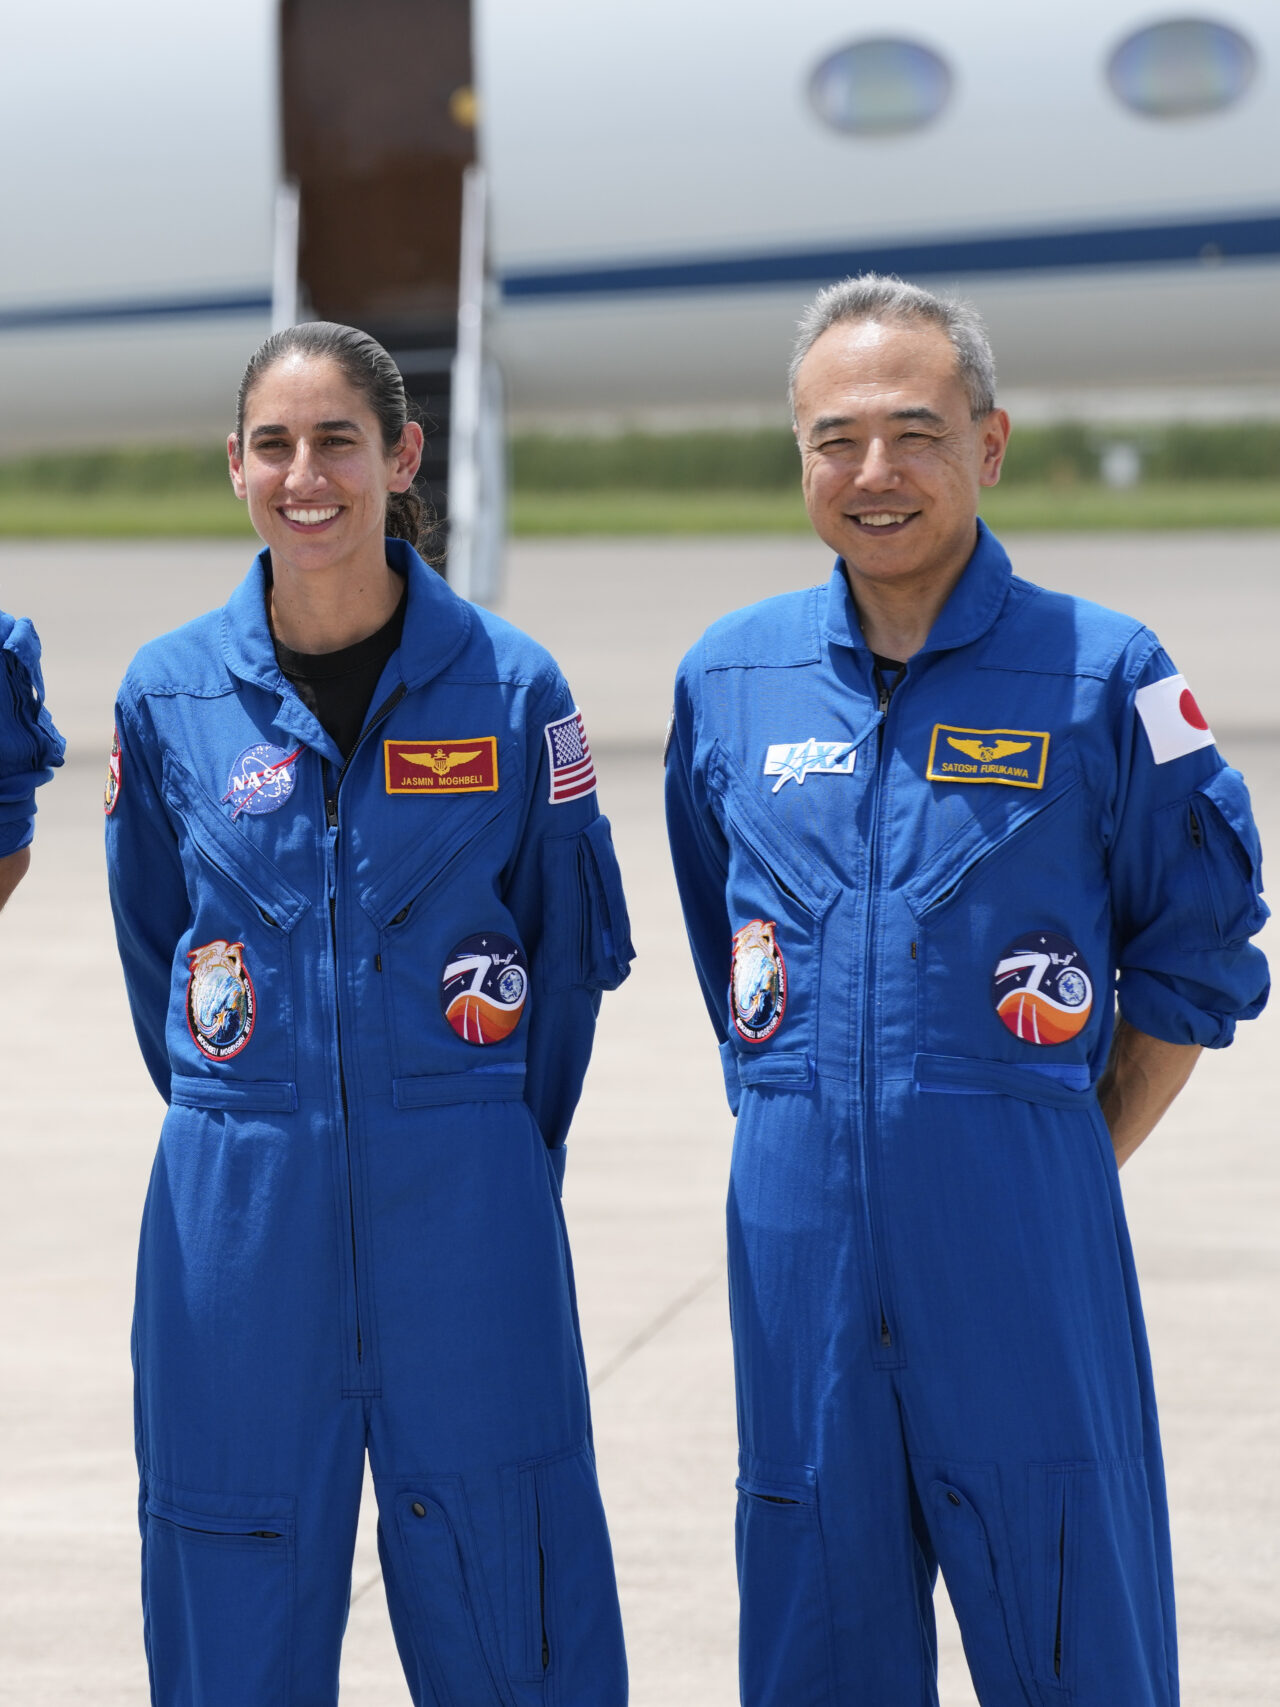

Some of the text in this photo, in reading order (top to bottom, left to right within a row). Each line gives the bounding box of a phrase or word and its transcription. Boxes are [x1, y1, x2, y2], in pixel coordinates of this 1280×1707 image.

[232, 765, 292, 793] NASA
[941, 762, 1029, 779] SATOSHI FURUKAWA
[401, 775, 484, 787] JASMIN MOGHBELI
